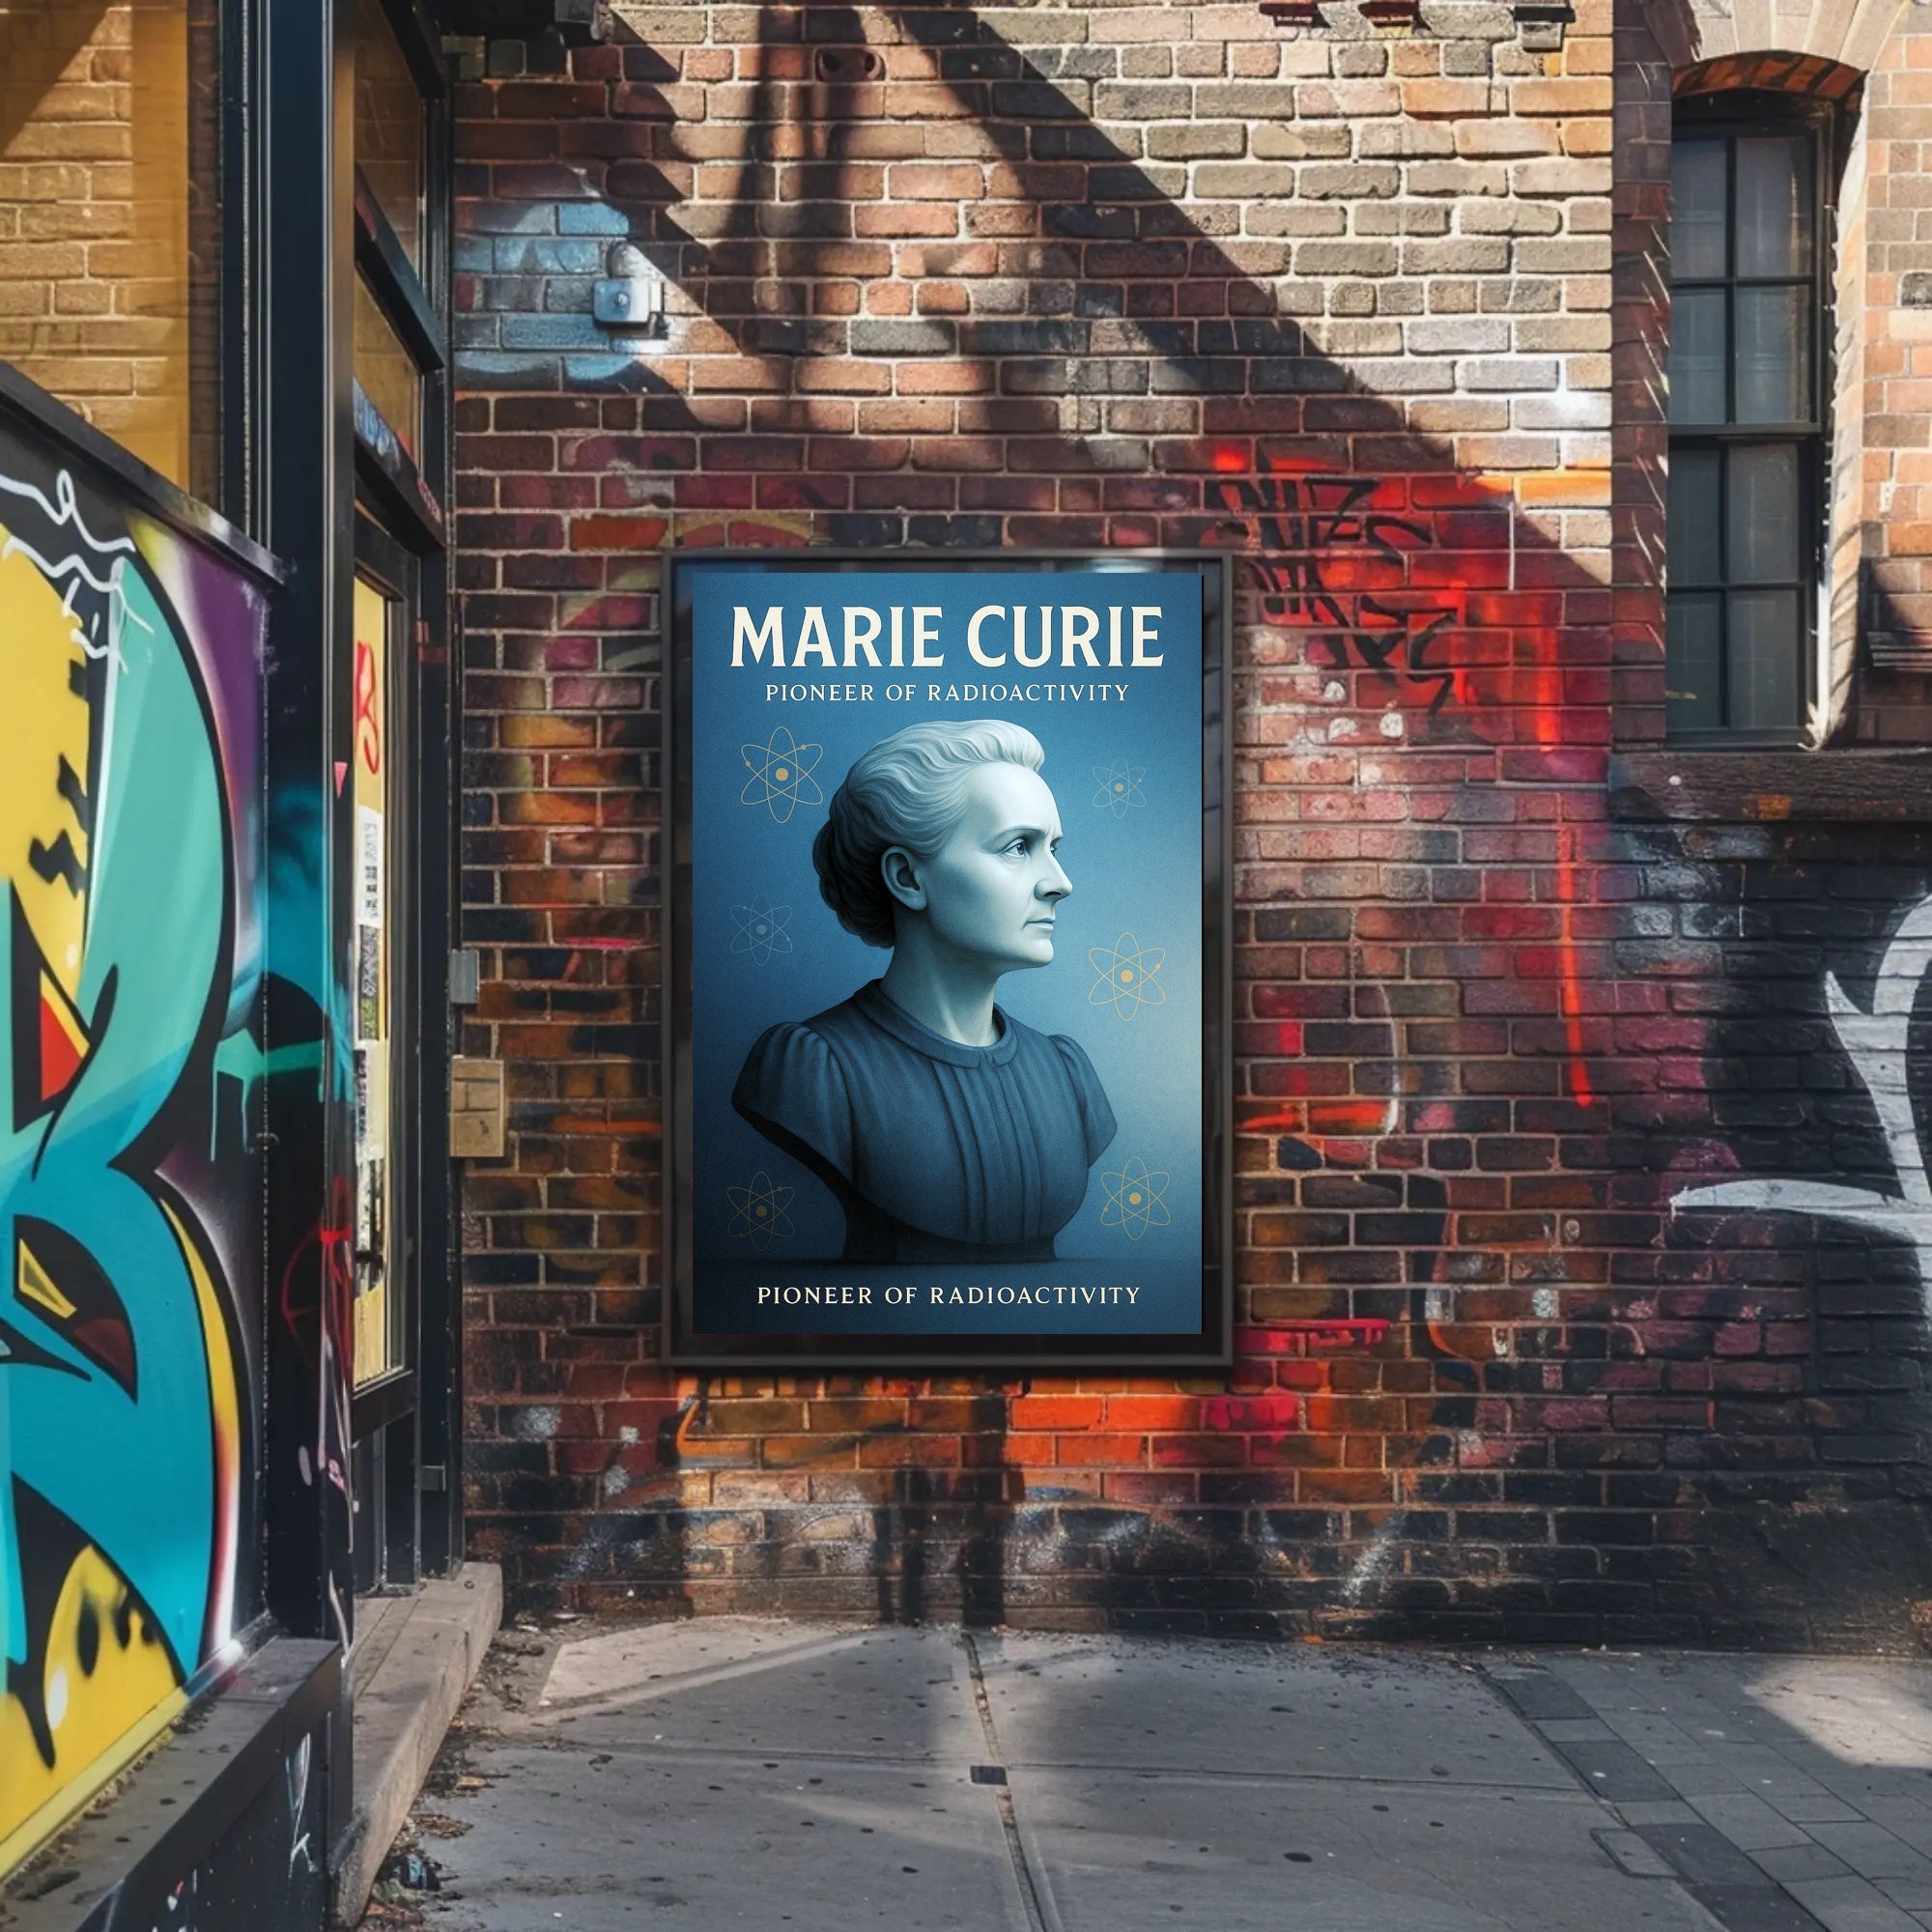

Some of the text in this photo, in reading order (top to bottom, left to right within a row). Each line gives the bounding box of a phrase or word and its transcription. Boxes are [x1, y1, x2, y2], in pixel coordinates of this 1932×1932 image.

[730, 604, 1165, 668] MARIE CURIE
[765, 683, 1130, 701] PIONEER OF RADIOACTIVITY
[757, 1286, 1142, 1305] PIONEER OF RADIOACTIVITY
